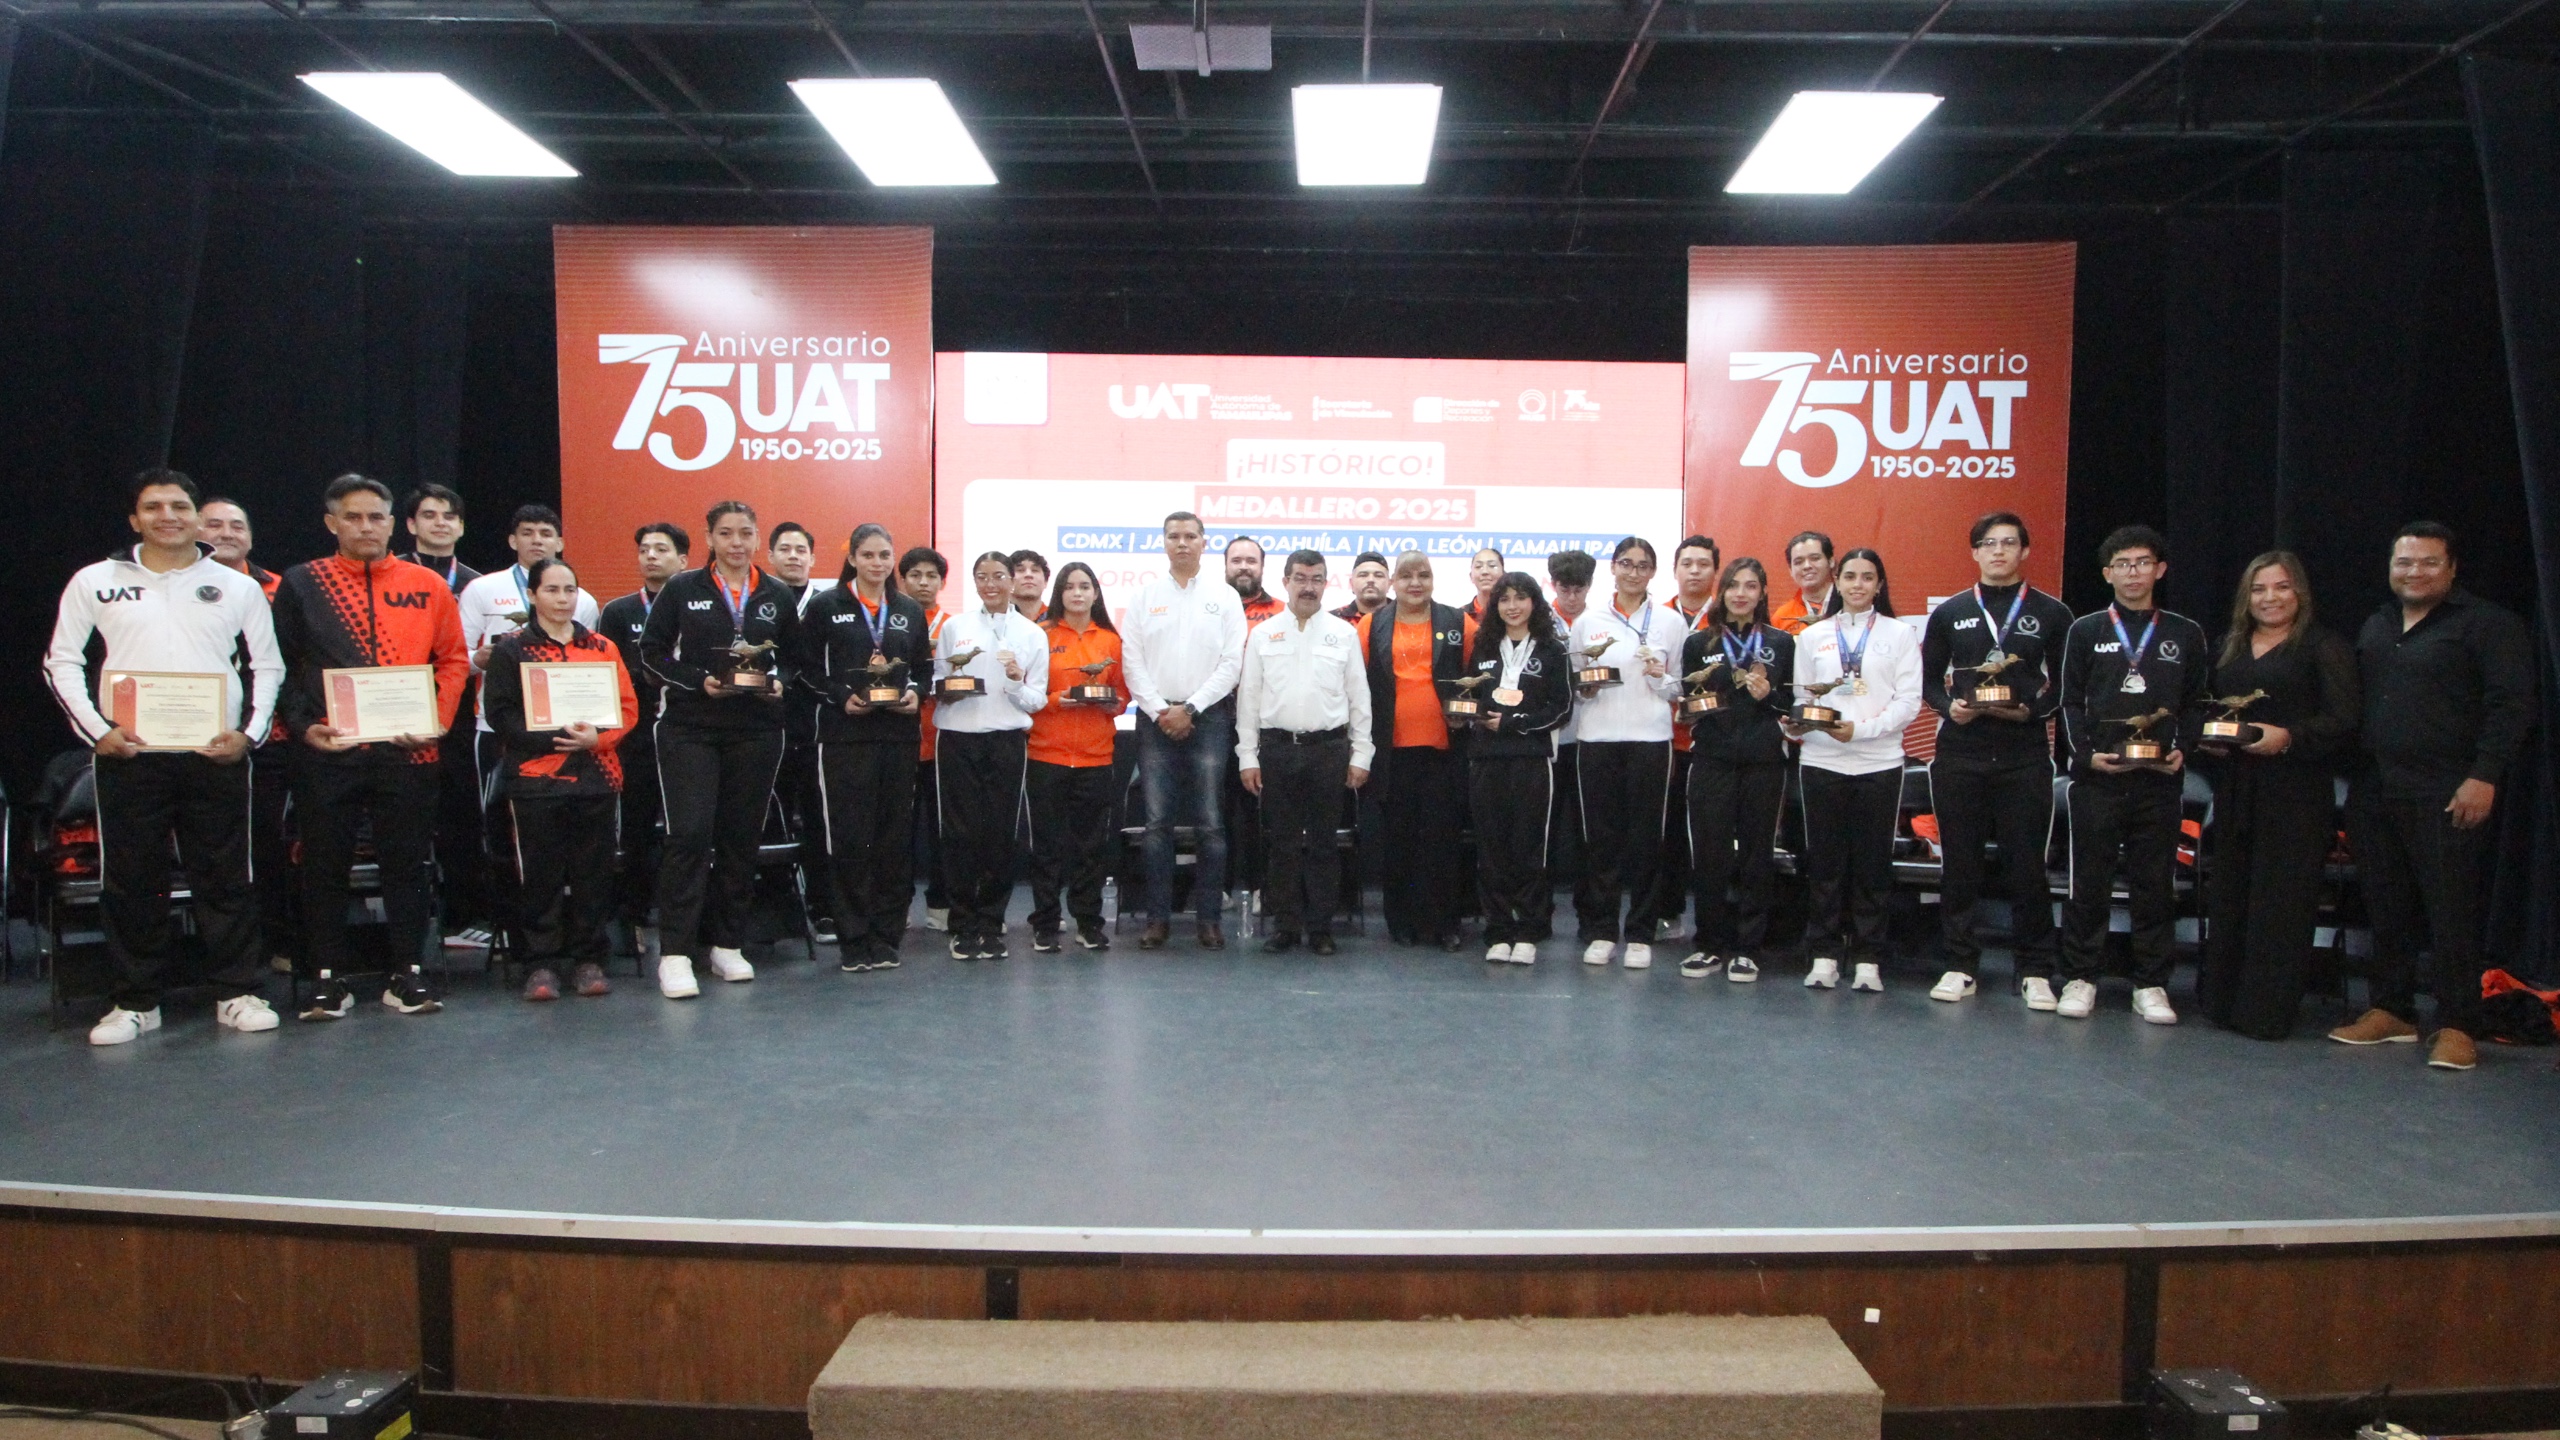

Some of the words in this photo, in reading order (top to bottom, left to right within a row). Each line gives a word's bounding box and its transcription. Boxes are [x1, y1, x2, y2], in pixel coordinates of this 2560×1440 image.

[693, 331, 891, 357] Aniversario
[1826, 348, 2029, 375] Aniversario
[598, 333, 737, 472] 75
[739, 362, 891, 433] UAT
[1108, 382, 1211, 420] UAT
[1729, 351, 1869, 488] 75
[1871, 380, 2028, 450] UAT
[739, 438, 883, 461] 1950-2025
[1236, 448, 1434, 479] ¡HISTÓRICO!
[1870, 455, 2017, 479] 1950-2025
[1200, 494, 1381, 520] MEDALLERO
[1387, 497, 1469, 521] 2025
[1061, 532, 1124, 549] CDMX
[1368, 536, 1421, 553] NVO.
[1426, 534, 1484, 555] LEÓN
[96, 586, 146, 604] UAT
[384, 591, 431, 609] UAT
[494, 598, 519, 606] UAT
[687, 600, 713, 611] UAT
[831, 613, 856, 624] UAT
[1953, 617, 1980, 631] UAT
[1591, 631, 1610, 641] UAT
[2094, 642, 2121, 653] UAT
[1478, 659, 1498, 670] UAT
[1702, 653, 1725, 664] UAT
